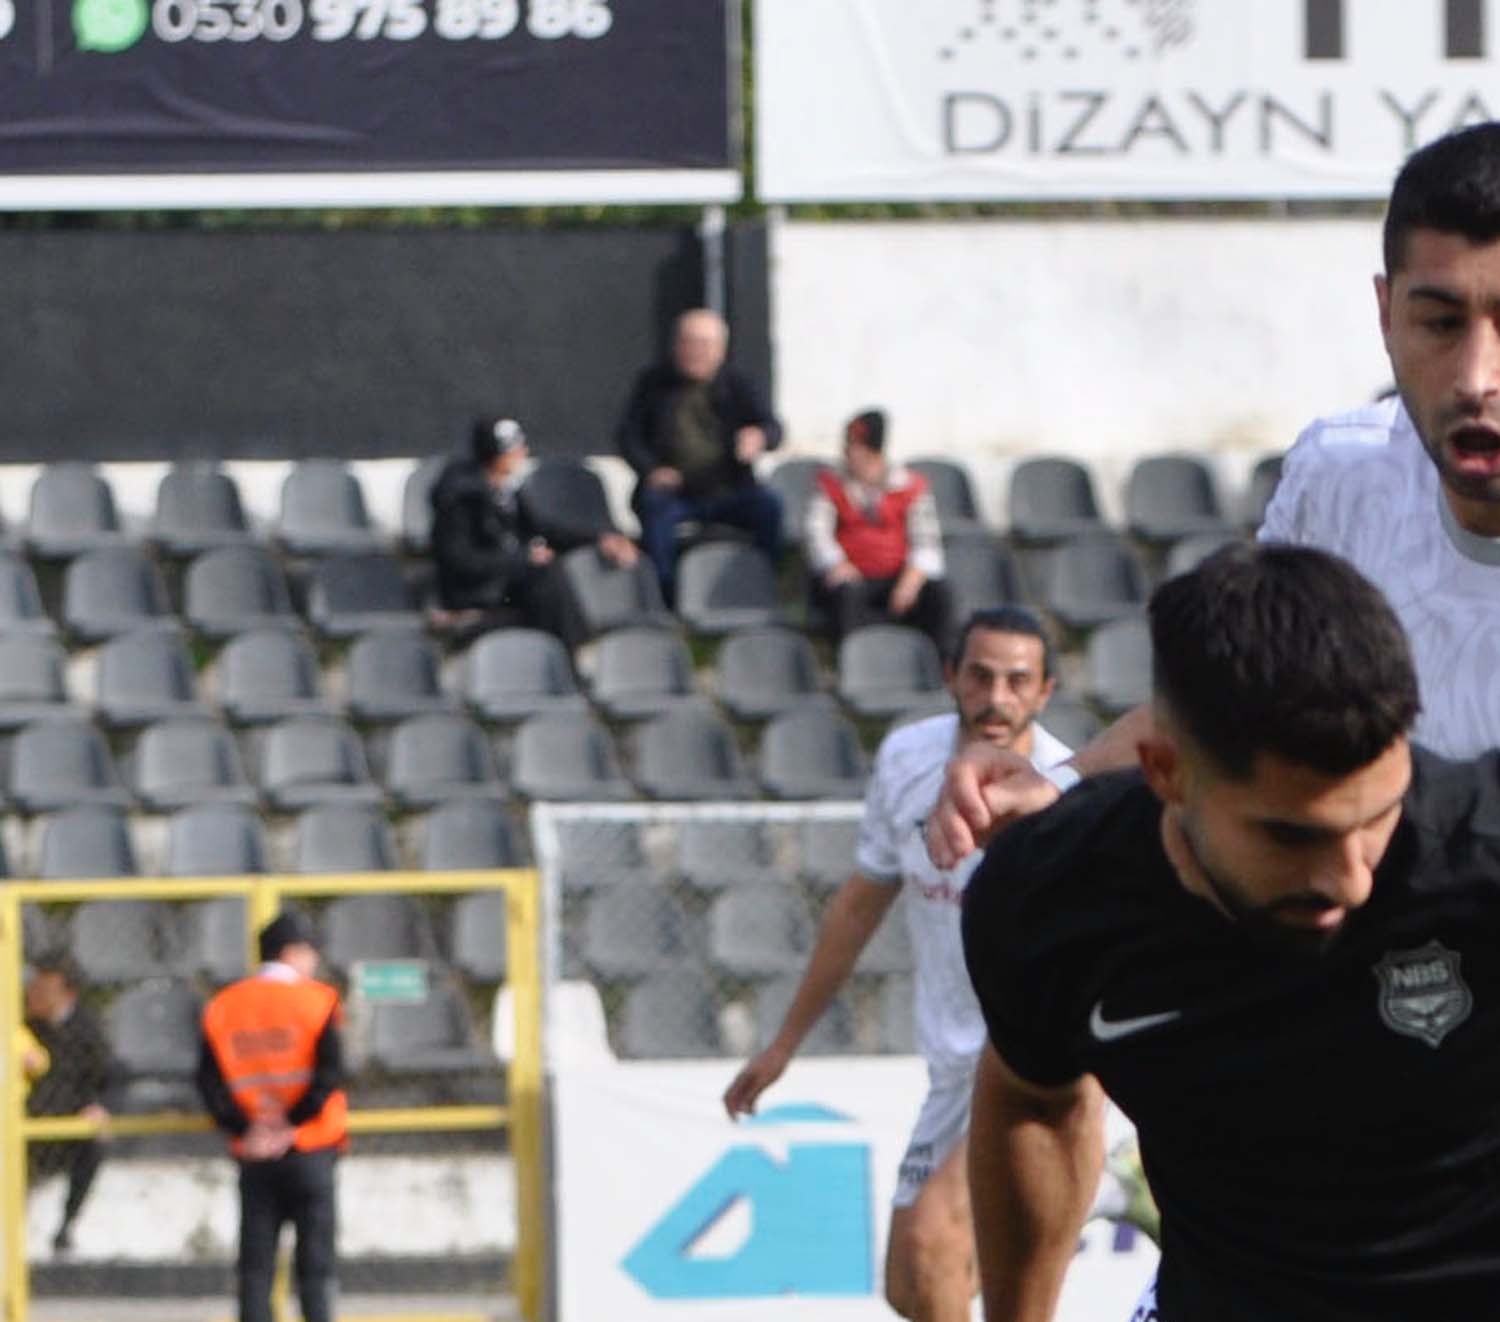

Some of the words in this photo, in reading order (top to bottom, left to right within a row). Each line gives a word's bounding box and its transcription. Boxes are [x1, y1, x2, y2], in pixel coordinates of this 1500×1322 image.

[152, 0, 305, 42] 0530
[309, 0, 427, 41] 975
[433, 0, 520, 40] 89
